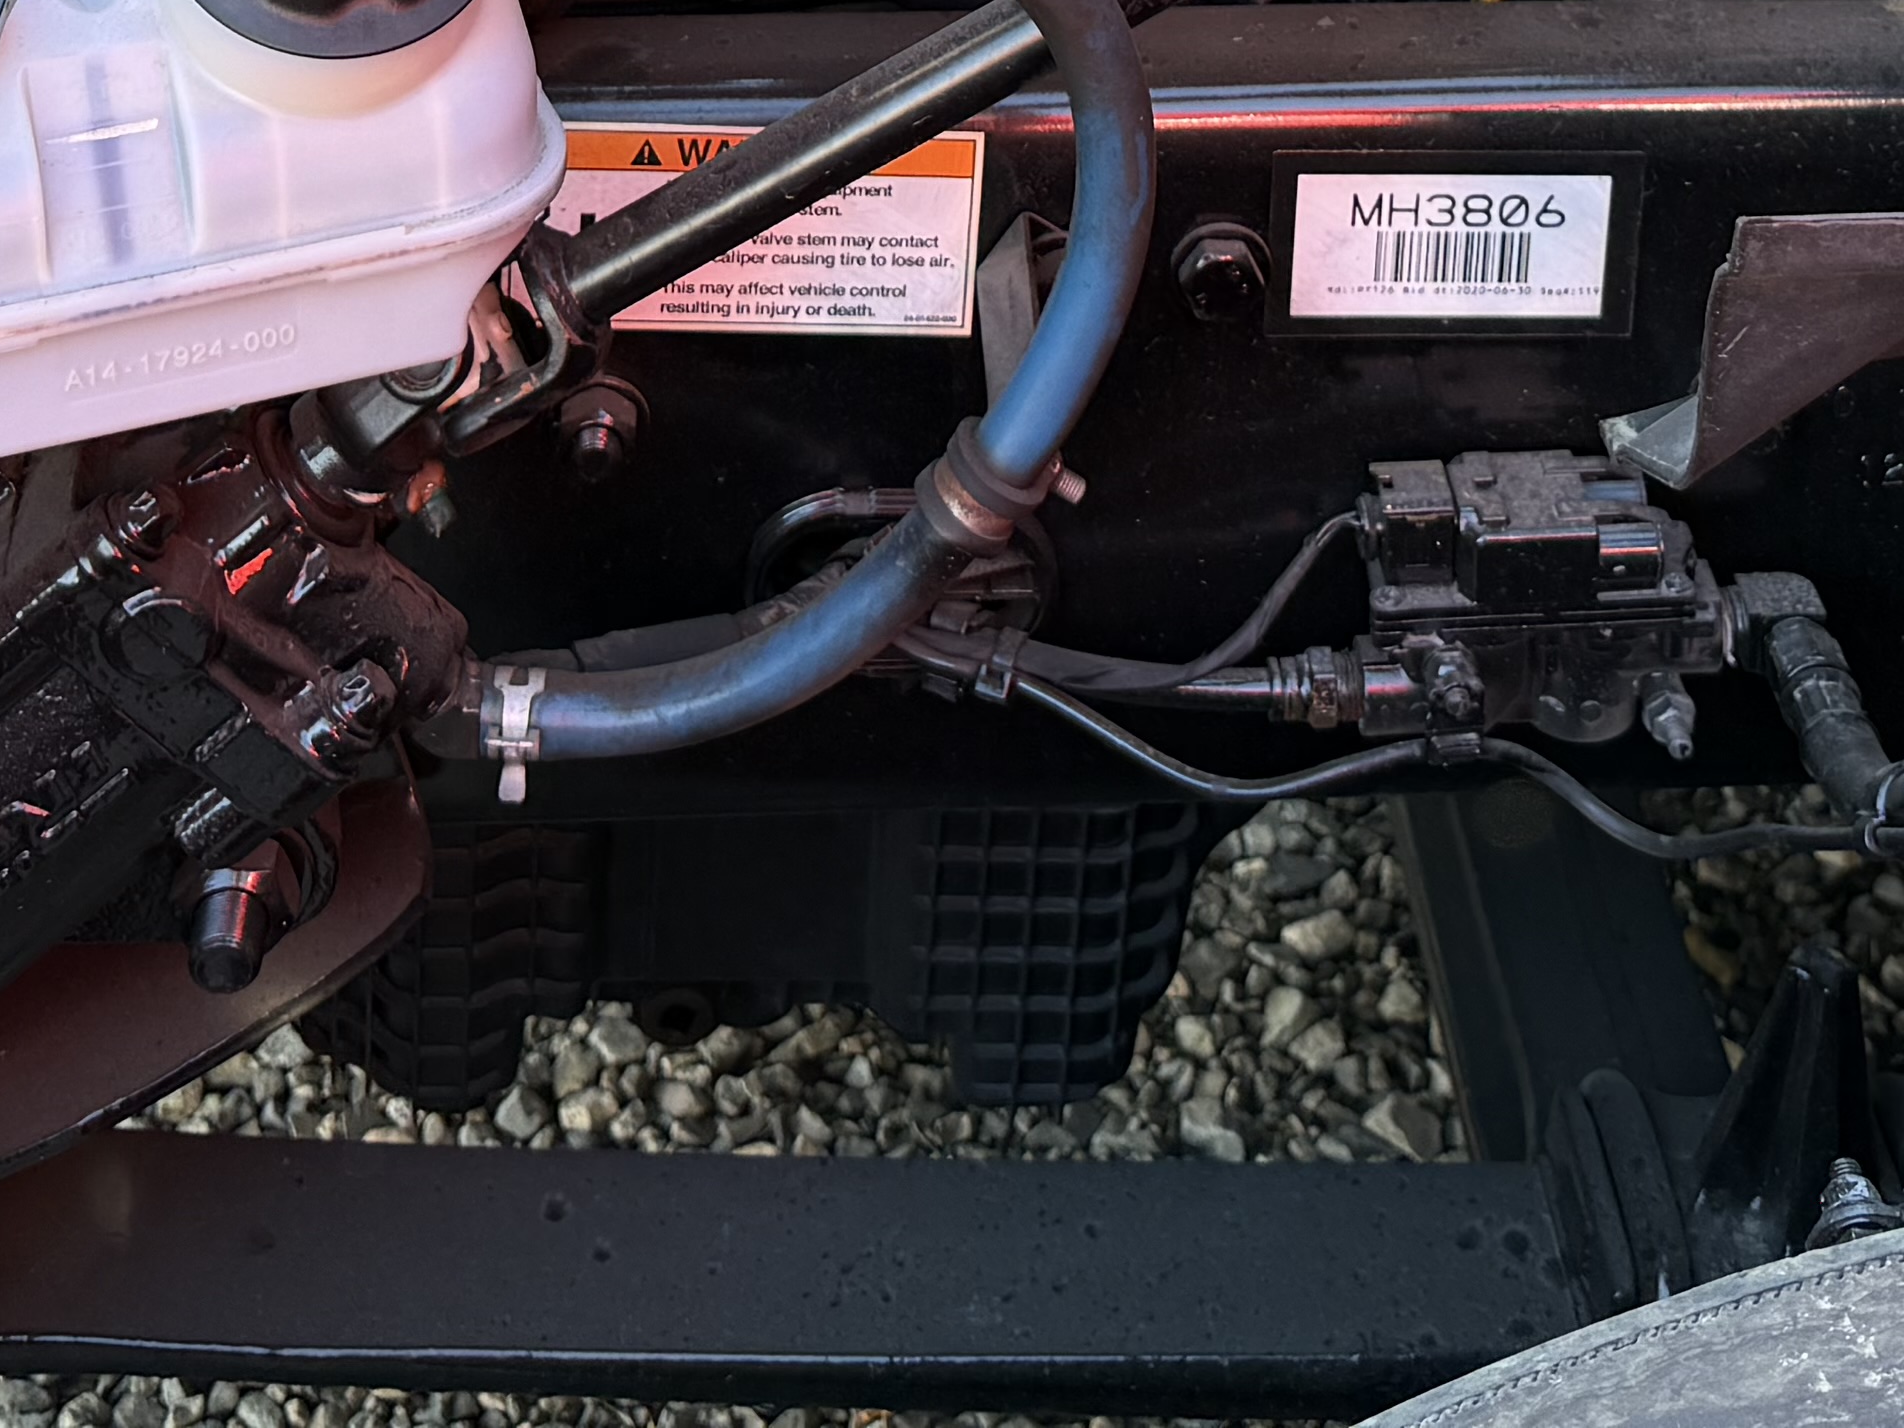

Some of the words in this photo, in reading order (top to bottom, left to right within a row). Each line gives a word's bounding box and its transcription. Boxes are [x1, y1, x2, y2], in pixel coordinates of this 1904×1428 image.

[1350, 192, 1566, 228] MH3806
[797, 235, 837, 246] stem
[840, 235, 876, 249] may
[879, 234, 938, 248] contact
[712, 253, 768, 268] caliper
[771, 254, 834, 268] causing
[840, 253, 866, 266] tire
[871, 254, 886, 266] to
[891, 252, 924, 267] lose
[929, 253, 955, 268] air.
[662, 282, 694, 294] This
[700, 283, 734, 297] may
[738, 282, 784, 296] affect
[788, 284, 846, 297] vehicle
[850, 284, 907, 298] control
[660, 302, 730, 317] resulting
[736, 302, 750, 314] in
[756, 302, 801, 318] injury
[806, 304, 824, 316] or
[827, 302, 876, 317] death.
[64, 323, 296, 393] A14-17924-000
